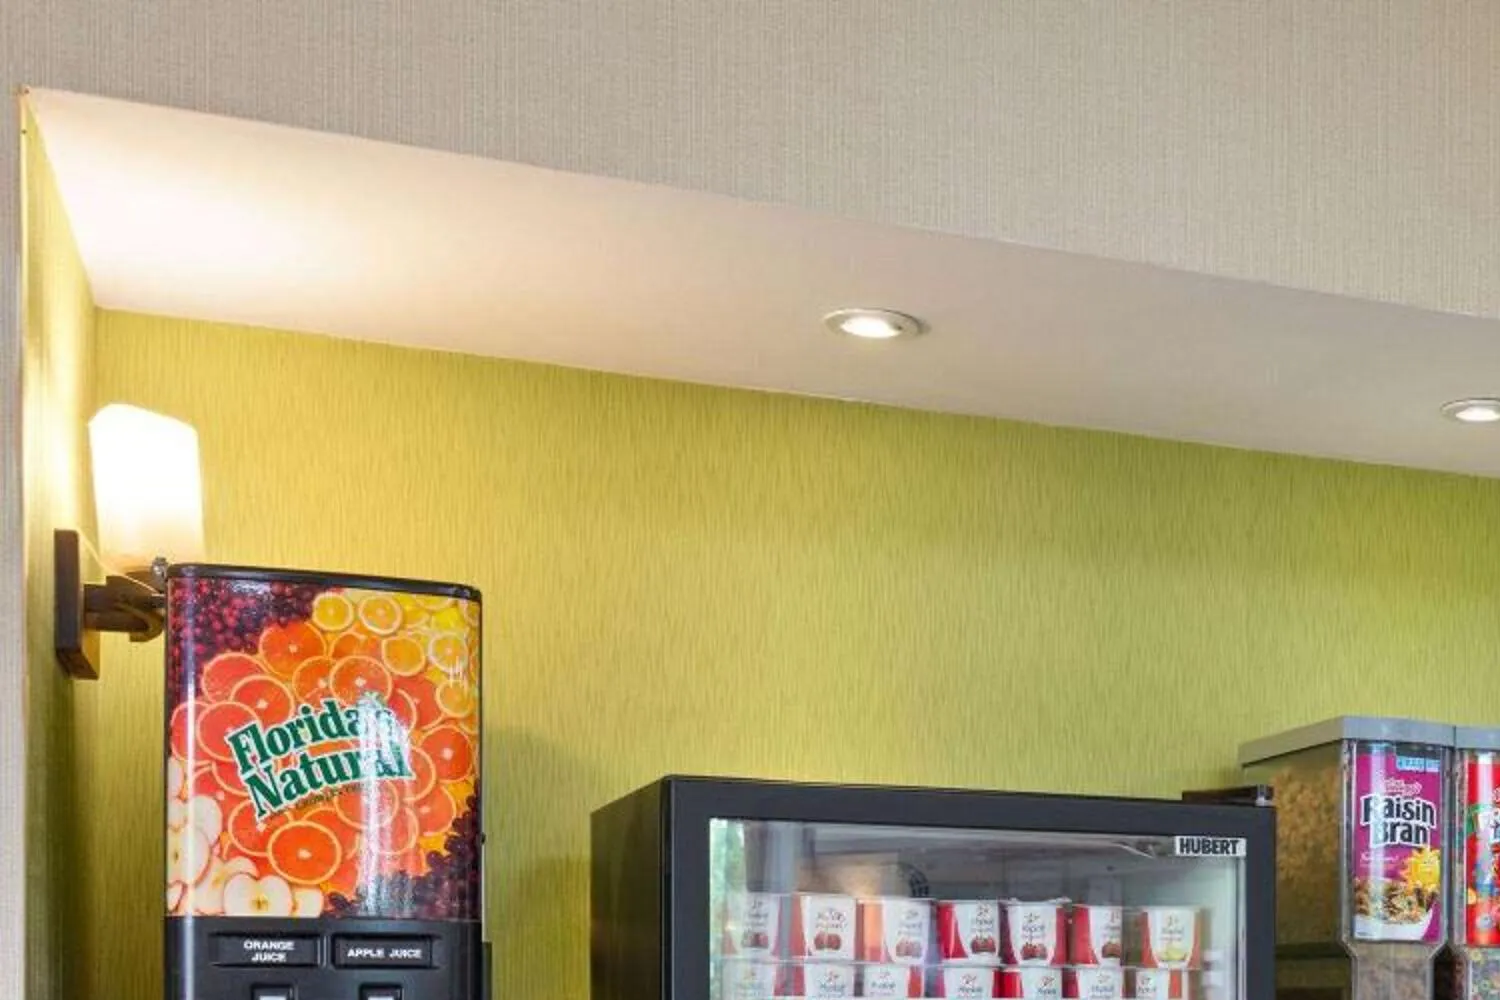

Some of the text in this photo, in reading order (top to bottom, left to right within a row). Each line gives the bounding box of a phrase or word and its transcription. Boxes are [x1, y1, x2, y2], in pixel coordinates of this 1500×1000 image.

[227, 700, 396, 772] Florida
[1179, 838, 1240, 854] HUBERT
[243, 940, 295, 951] ORANGE
[251, 952, 287, 963] JUICE
[347, 948, 422, 959] APPLE JUICE
